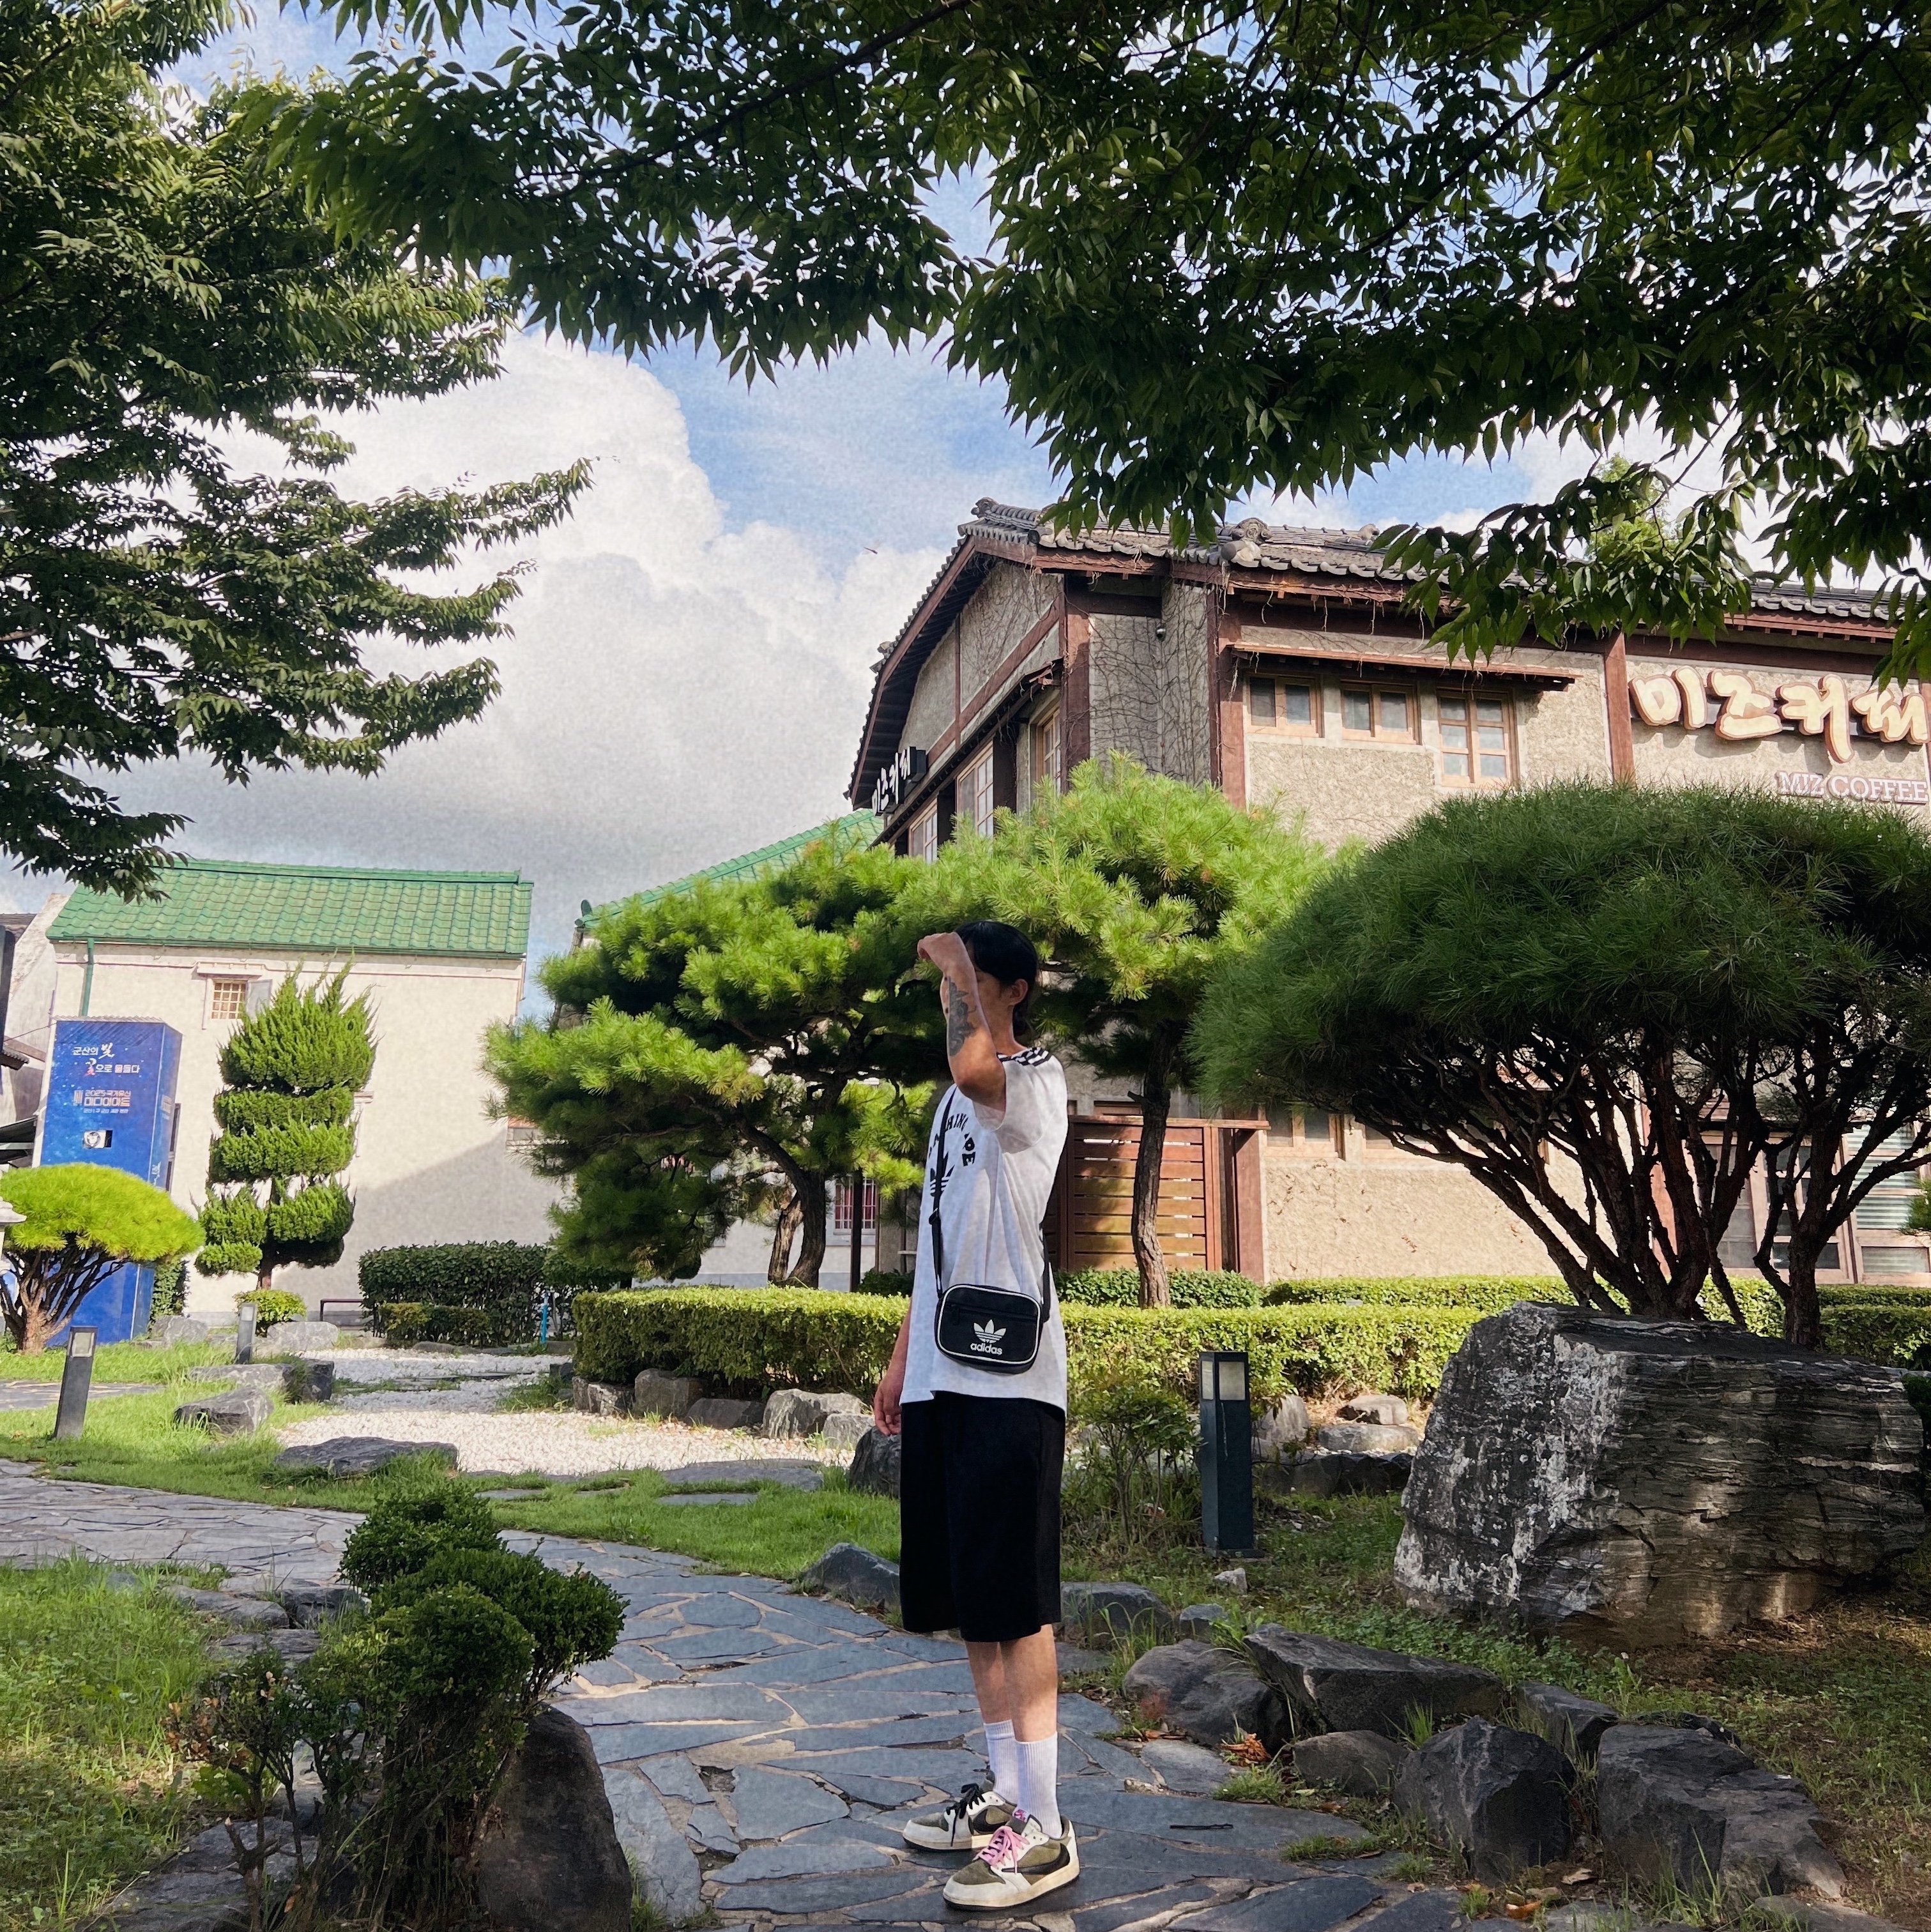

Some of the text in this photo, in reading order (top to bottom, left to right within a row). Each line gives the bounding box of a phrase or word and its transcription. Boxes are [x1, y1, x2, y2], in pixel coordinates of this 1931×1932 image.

[1628, 665, 1930, 763] 미즈커피
[1776, 771, 1929, 803] MIZ COFFEE
[72, 1046, 98, 1056] 군산의
[84, 1097, 130, 1107] 미디어아트
[970, 1343, 1003, 1355] adidas
